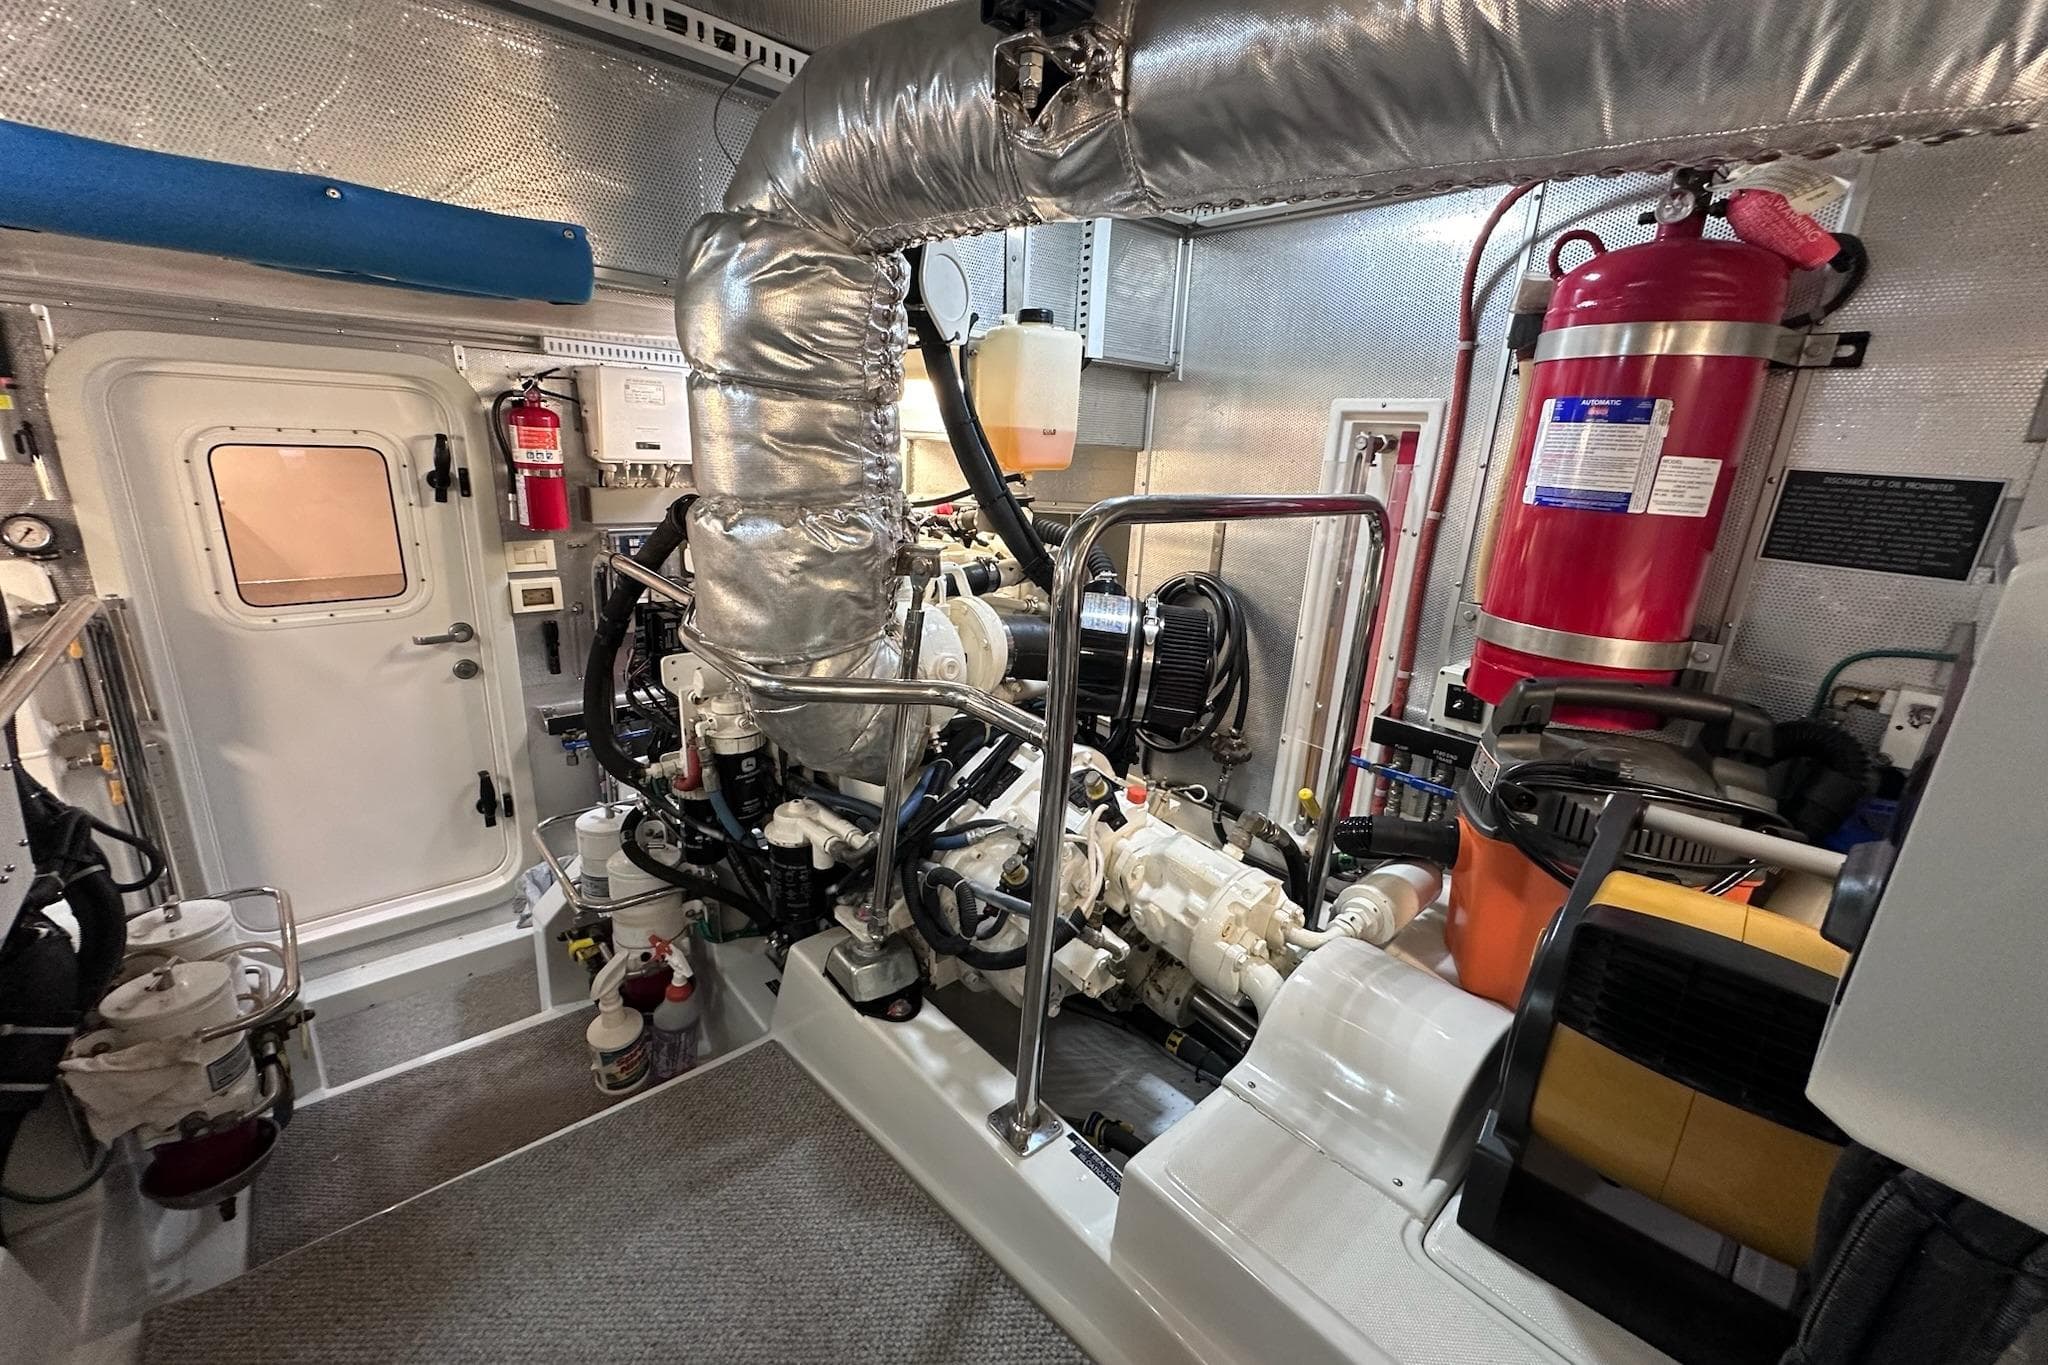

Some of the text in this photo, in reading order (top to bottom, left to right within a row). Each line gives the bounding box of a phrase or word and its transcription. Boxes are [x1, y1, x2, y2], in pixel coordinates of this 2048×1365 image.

[1775, 198, 1822, 243] WARNING
[1823, 476, 1956, 492] DISCHARGE OF OIL PROHIBITED
[1091, 1153, 1107, 1169] SEAL
[1106, 1176, 1121, 1193] VALV
